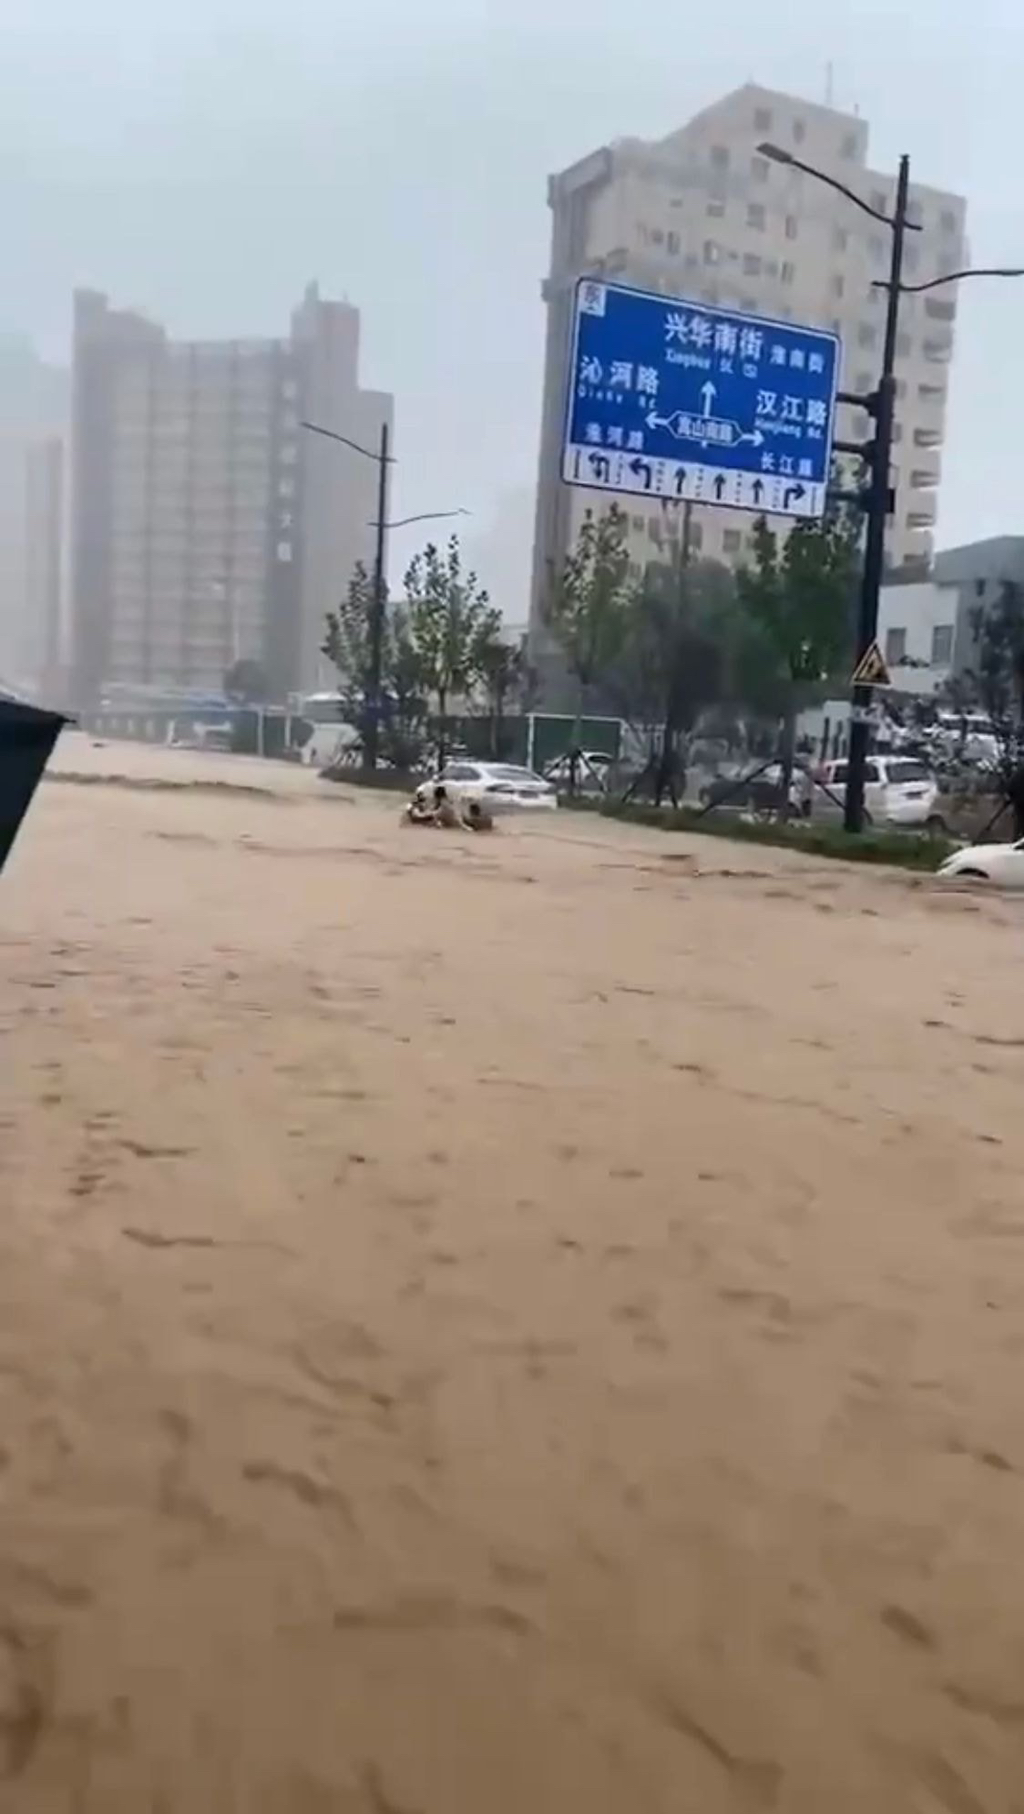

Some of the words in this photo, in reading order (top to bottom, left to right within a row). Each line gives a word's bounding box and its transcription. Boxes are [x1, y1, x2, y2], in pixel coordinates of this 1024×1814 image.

[664, 312, 764, 361] 兴华南街
[579, 355, 660, 395] 沁河路
[756, 389, 827, 426] 汉江路
